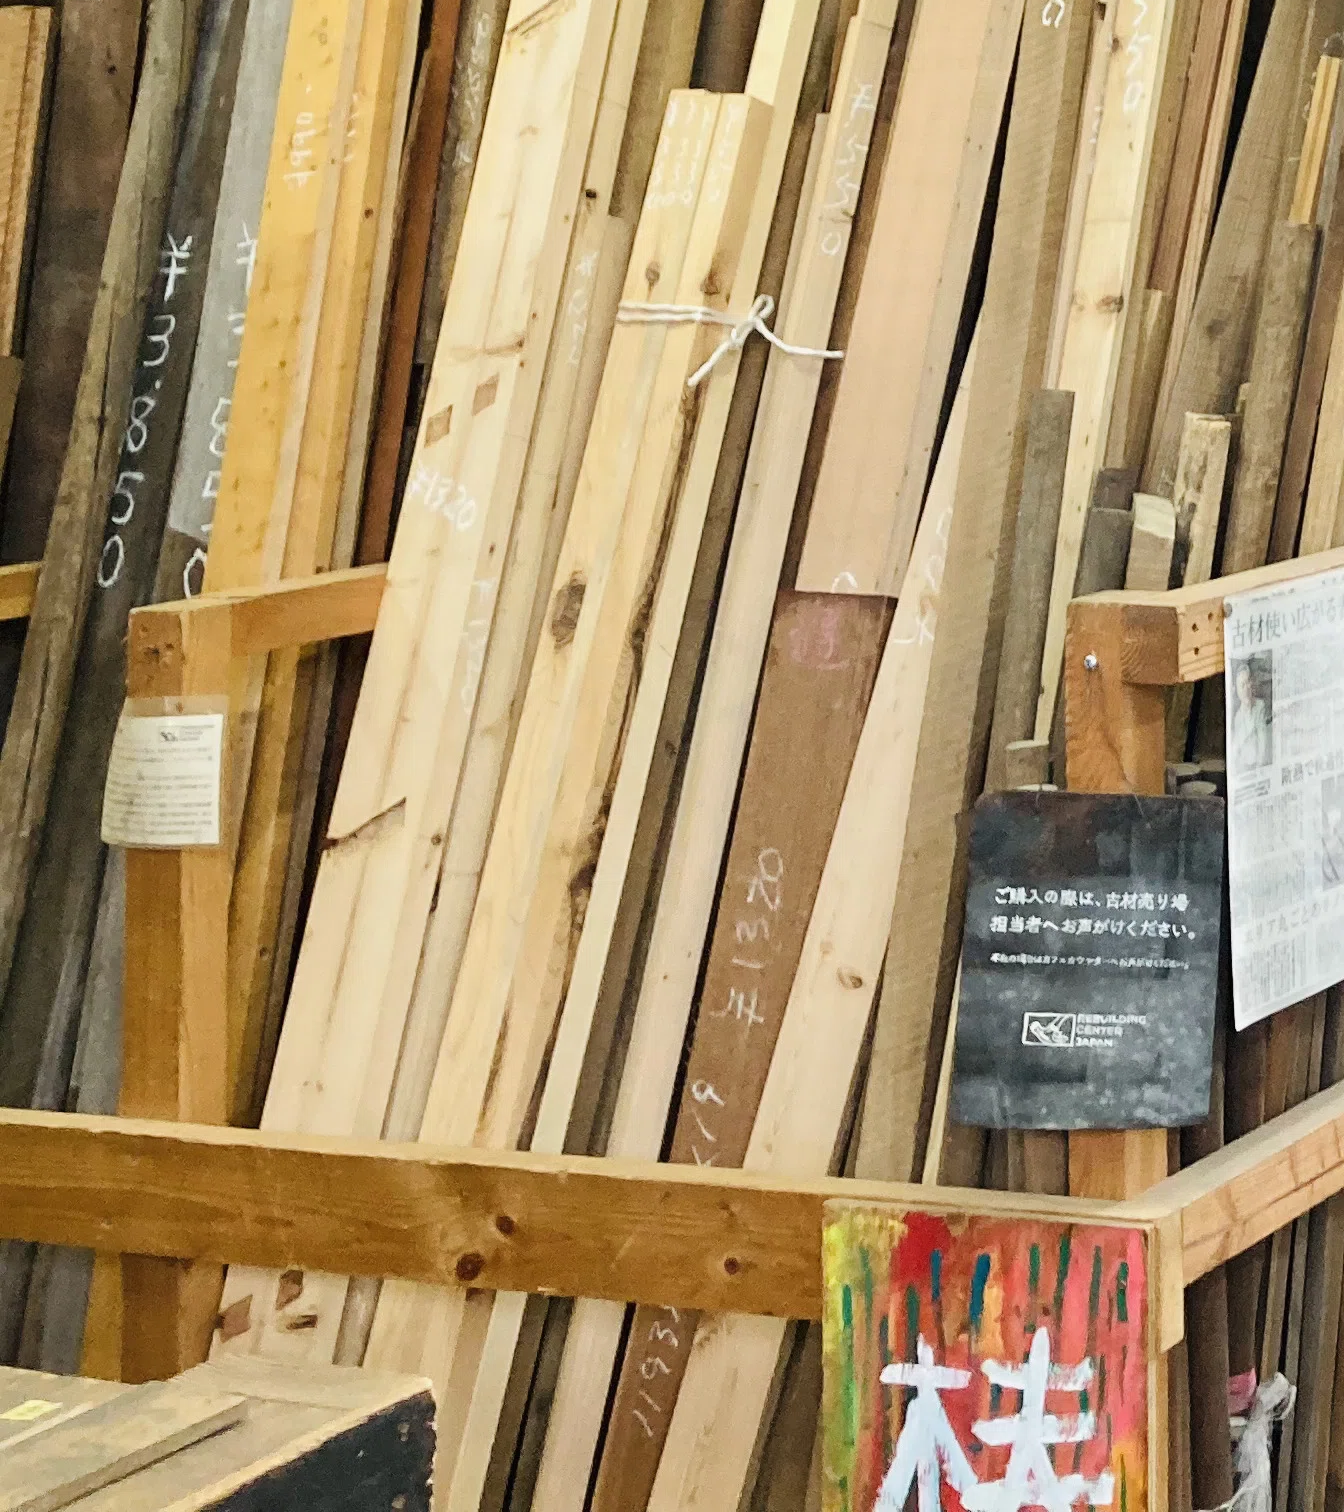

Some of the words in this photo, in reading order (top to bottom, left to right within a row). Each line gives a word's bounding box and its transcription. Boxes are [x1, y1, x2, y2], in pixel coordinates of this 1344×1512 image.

[994, 885, 1190, 913] ご購入の際は、古材売り場
[989, 914, 1196, 940] 担当者へお声がけください。
[1077, 1013, 1147, 1026] REBUILDING
[1076, 1025, 1124, 1038] CENTER
[1075, 1036, 1114, 1048] JAPAN
